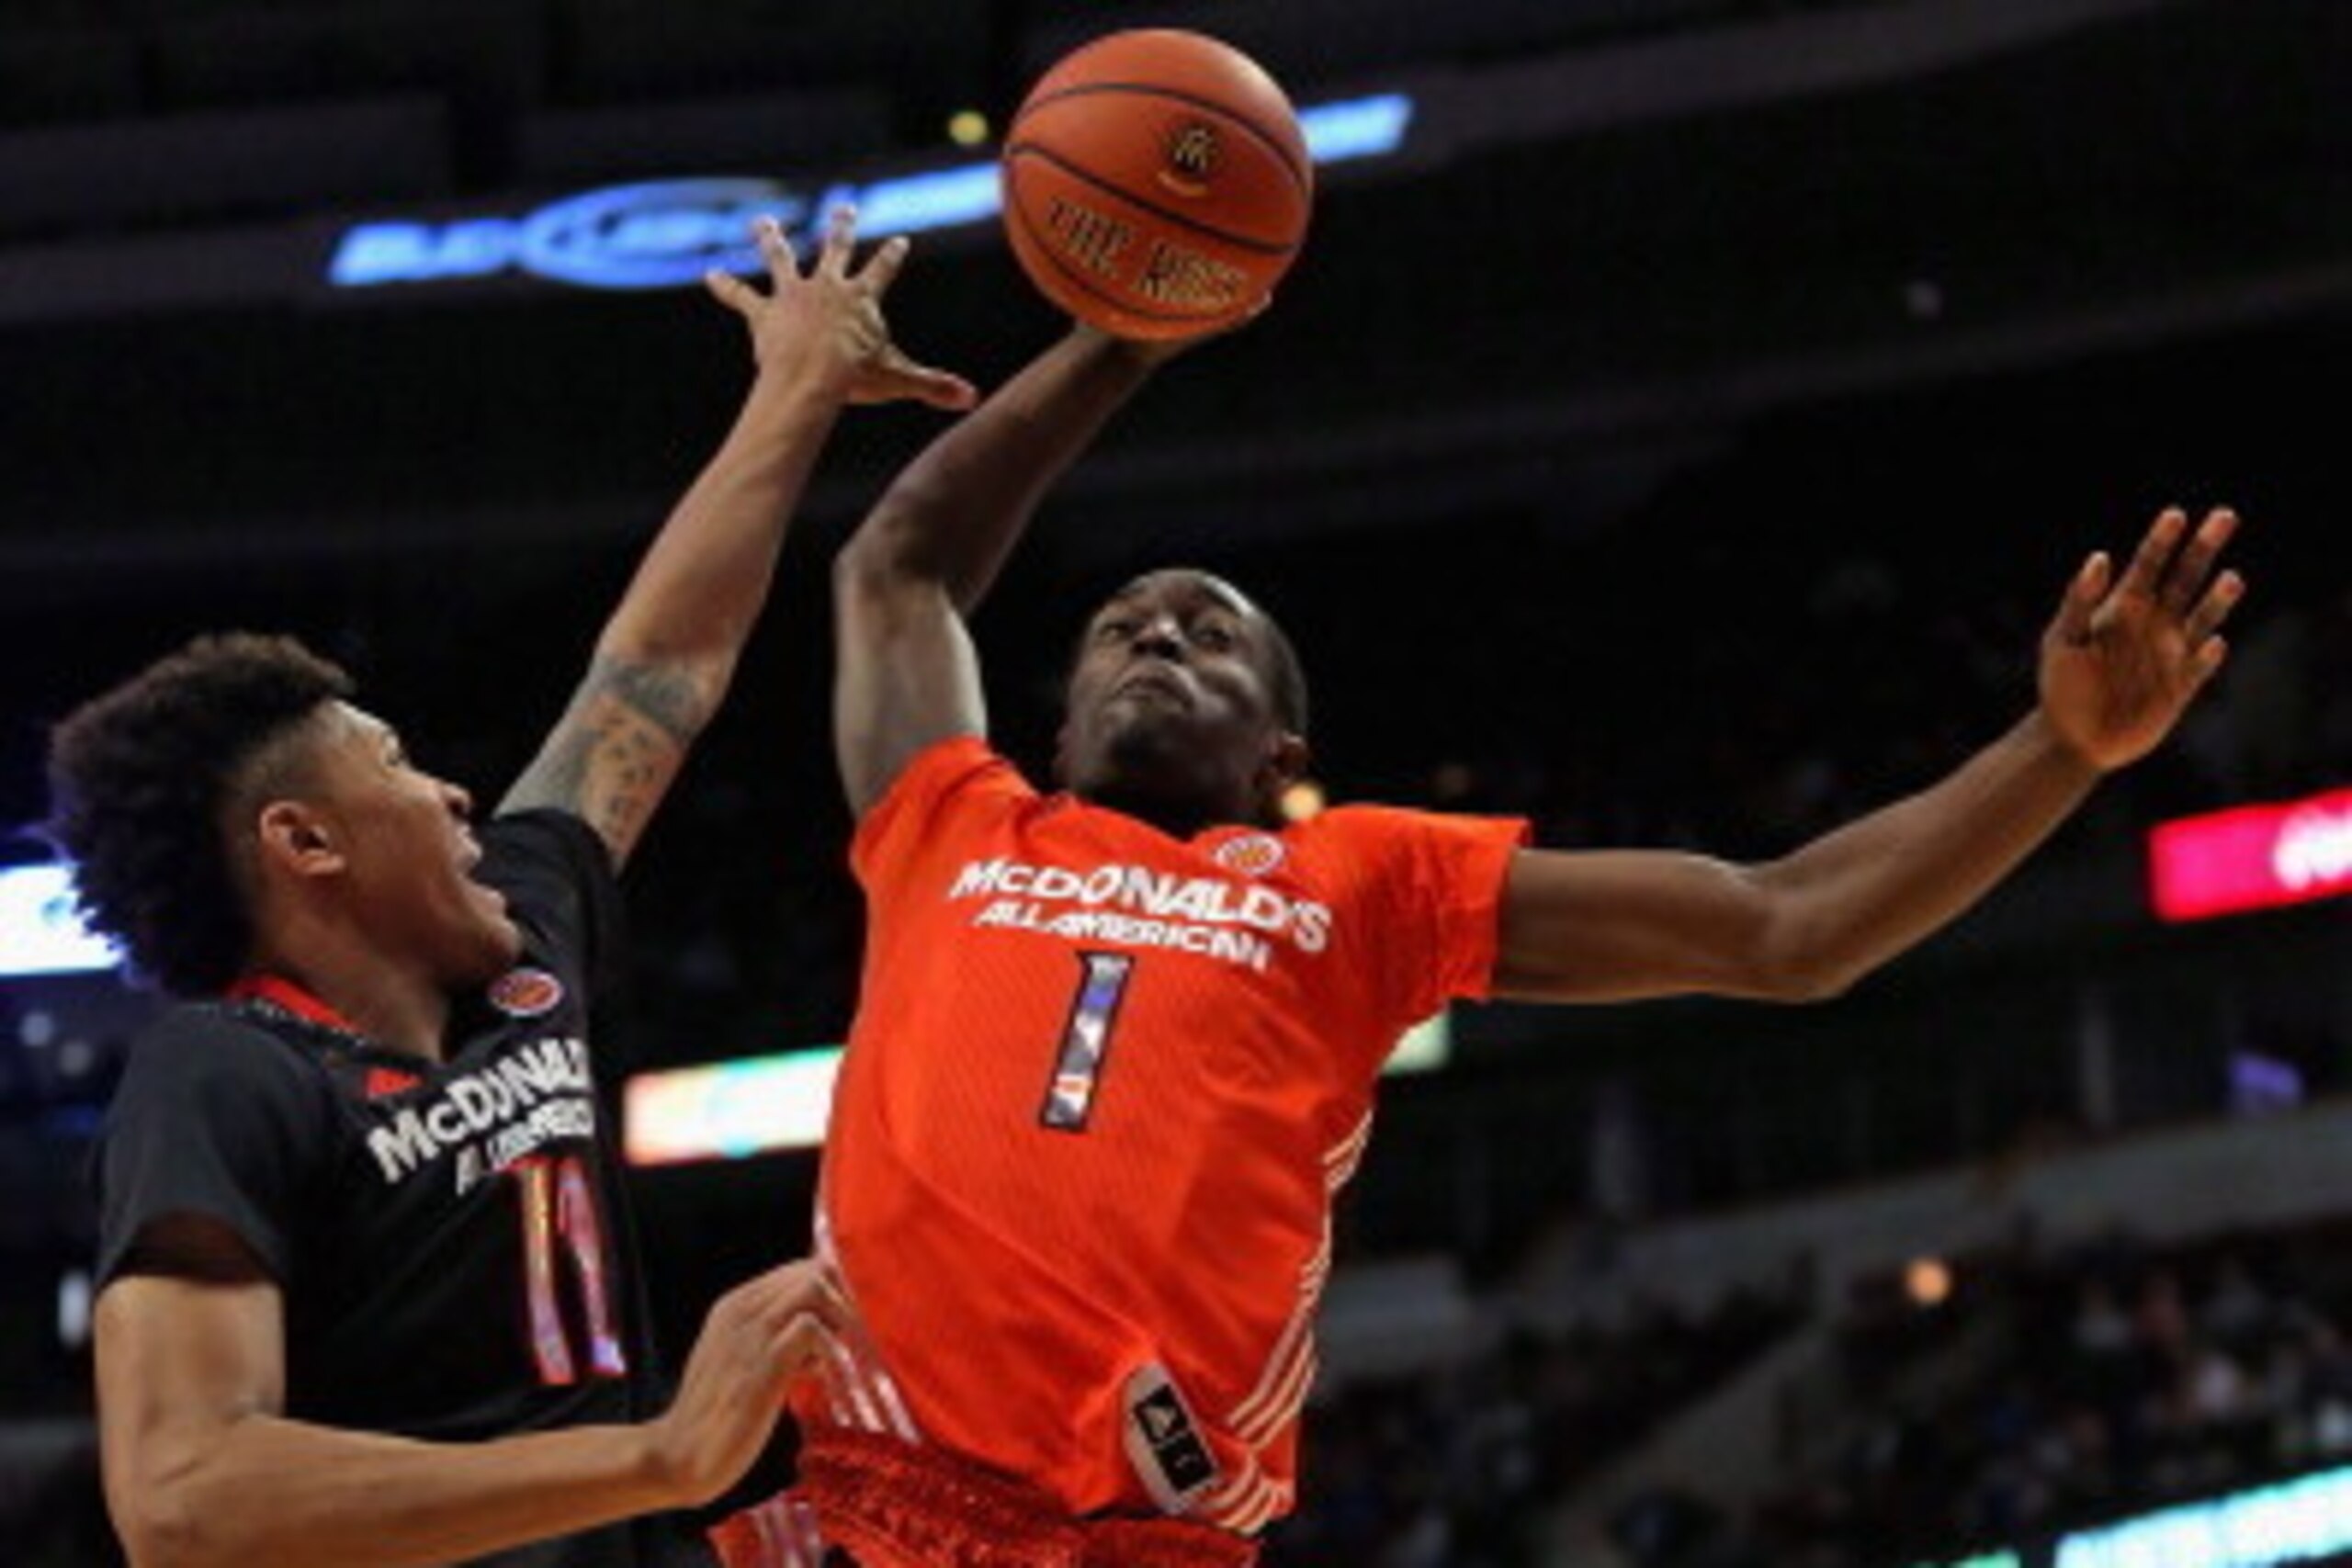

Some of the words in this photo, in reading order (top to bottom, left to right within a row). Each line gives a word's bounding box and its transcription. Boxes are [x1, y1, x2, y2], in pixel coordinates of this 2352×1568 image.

[1045, 909, 1272, 975] AMERICAN
[1038, 949, 1135, 1133] 1
[499, 1151, 628, 1385] 11
